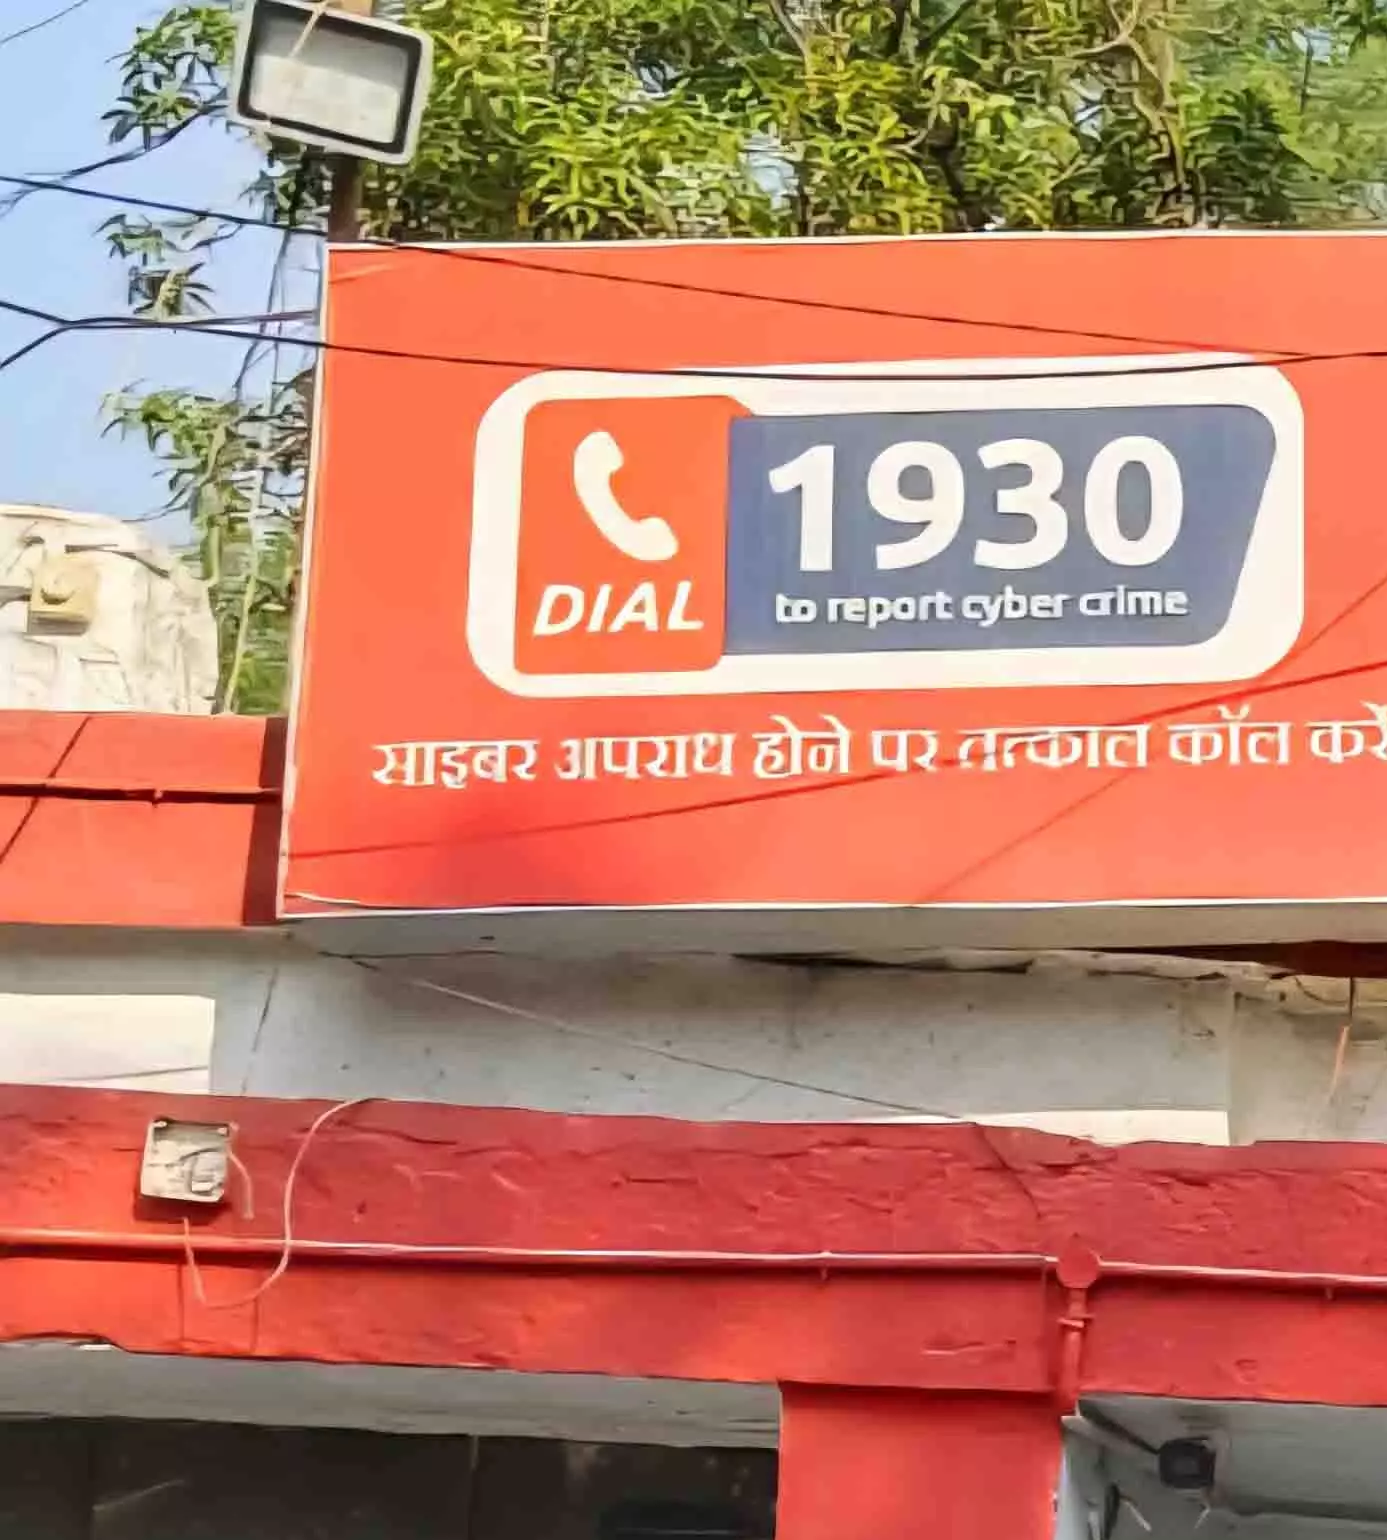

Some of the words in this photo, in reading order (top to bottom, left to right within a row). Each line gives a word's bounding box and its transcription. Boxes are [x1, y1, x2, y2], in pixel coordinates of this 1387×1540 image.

[769, 433, 1186, 573] 1930
[531, 580, 705, 640] DIAL
[775, 594, 817, 623] to
[827, 591, 954, 629] report
[961, 585, 1070, 628] cyber
[1079, 584, 1190, 617] crime
[371, 738, 540, 790] साइबर
[553, 731, 738, 781] अपराध
[752, 713, 852, 779] होने
[870, 728, 940, 773] पर
[957, 721, 1152, 772] तत्काल
[1167, 704, 1292, 767] कॉल
